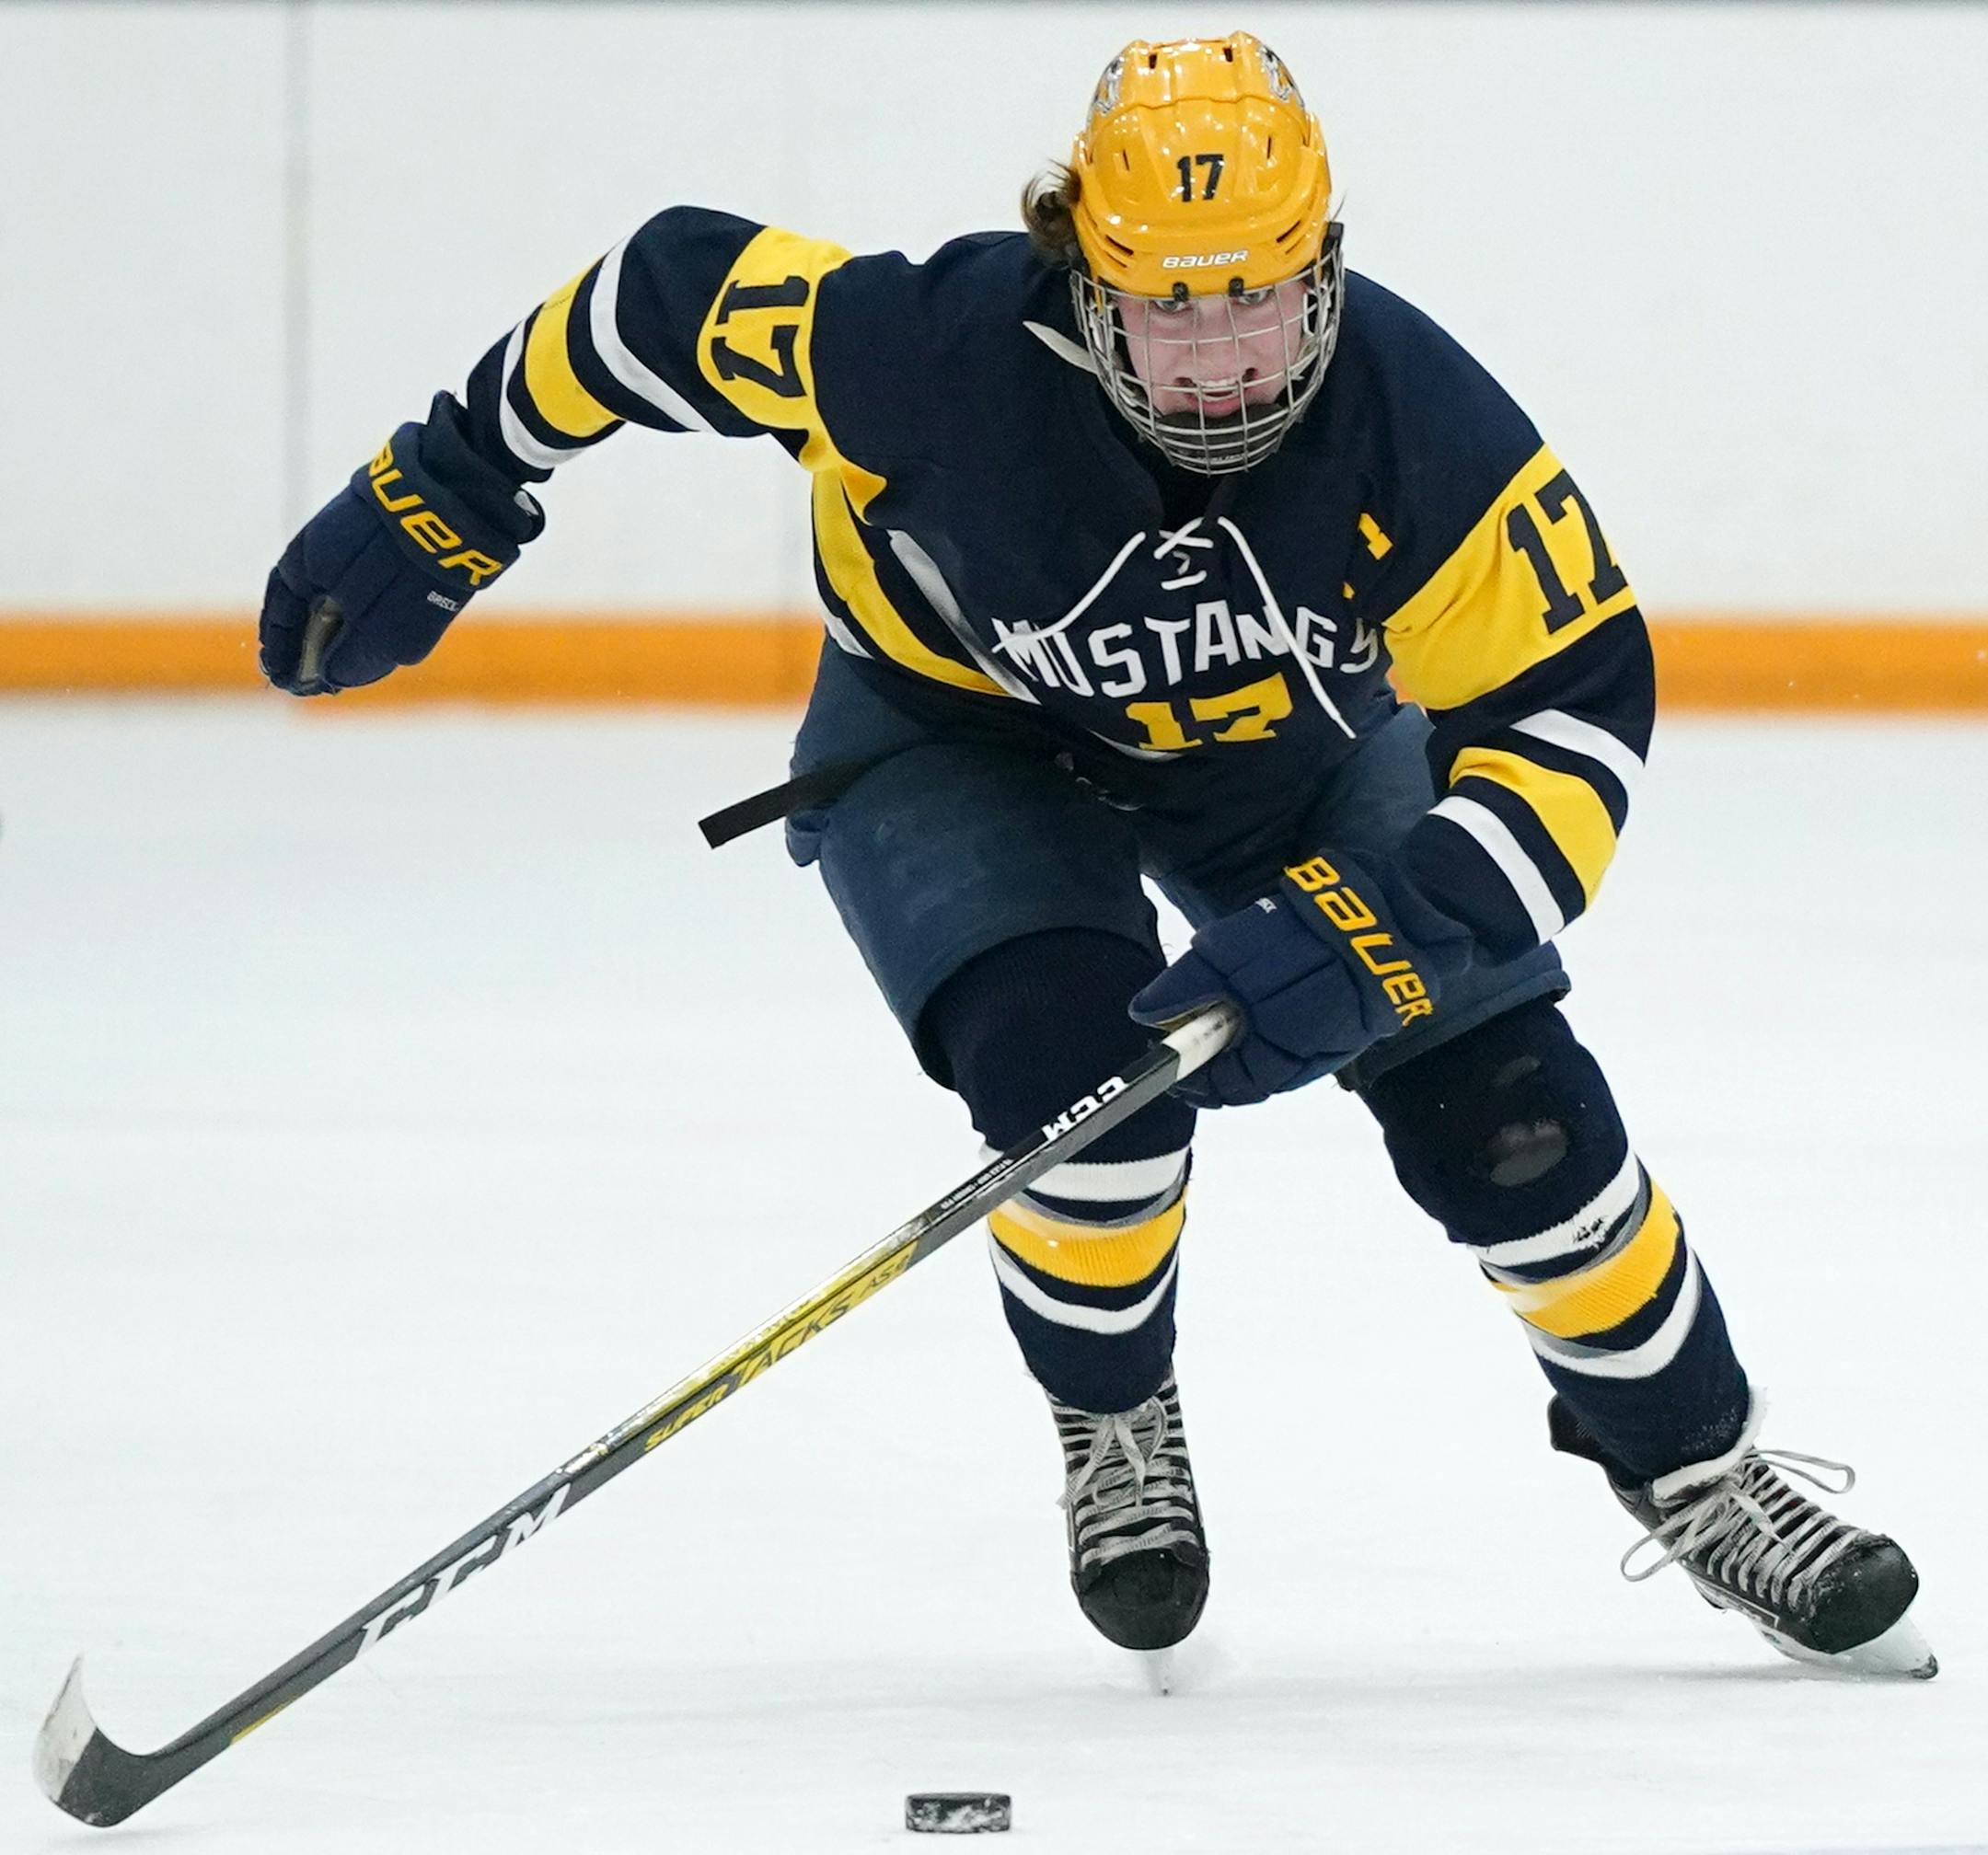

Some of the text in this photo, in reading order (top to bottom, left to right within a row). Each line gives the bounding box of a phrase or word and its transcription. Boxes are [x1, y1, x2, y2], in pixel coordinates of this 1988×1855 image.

[1176, 153, 1224, 202] 17
[1162, 249, 1248, 270] BAUER
[710, 275, 810, 398] 17
[368, 441, 503, 586] AUER
[1506, 467, 1629, 635] 17
[991, 600, 1379, 698] MUSTANGS
[1125, 673, 1293, 751] 17
[1283, 856, 1434, 1027] BAUER
[1041, 1076, 1130, 1142] CCM
[354, 1481, 572, 1659] CCM
